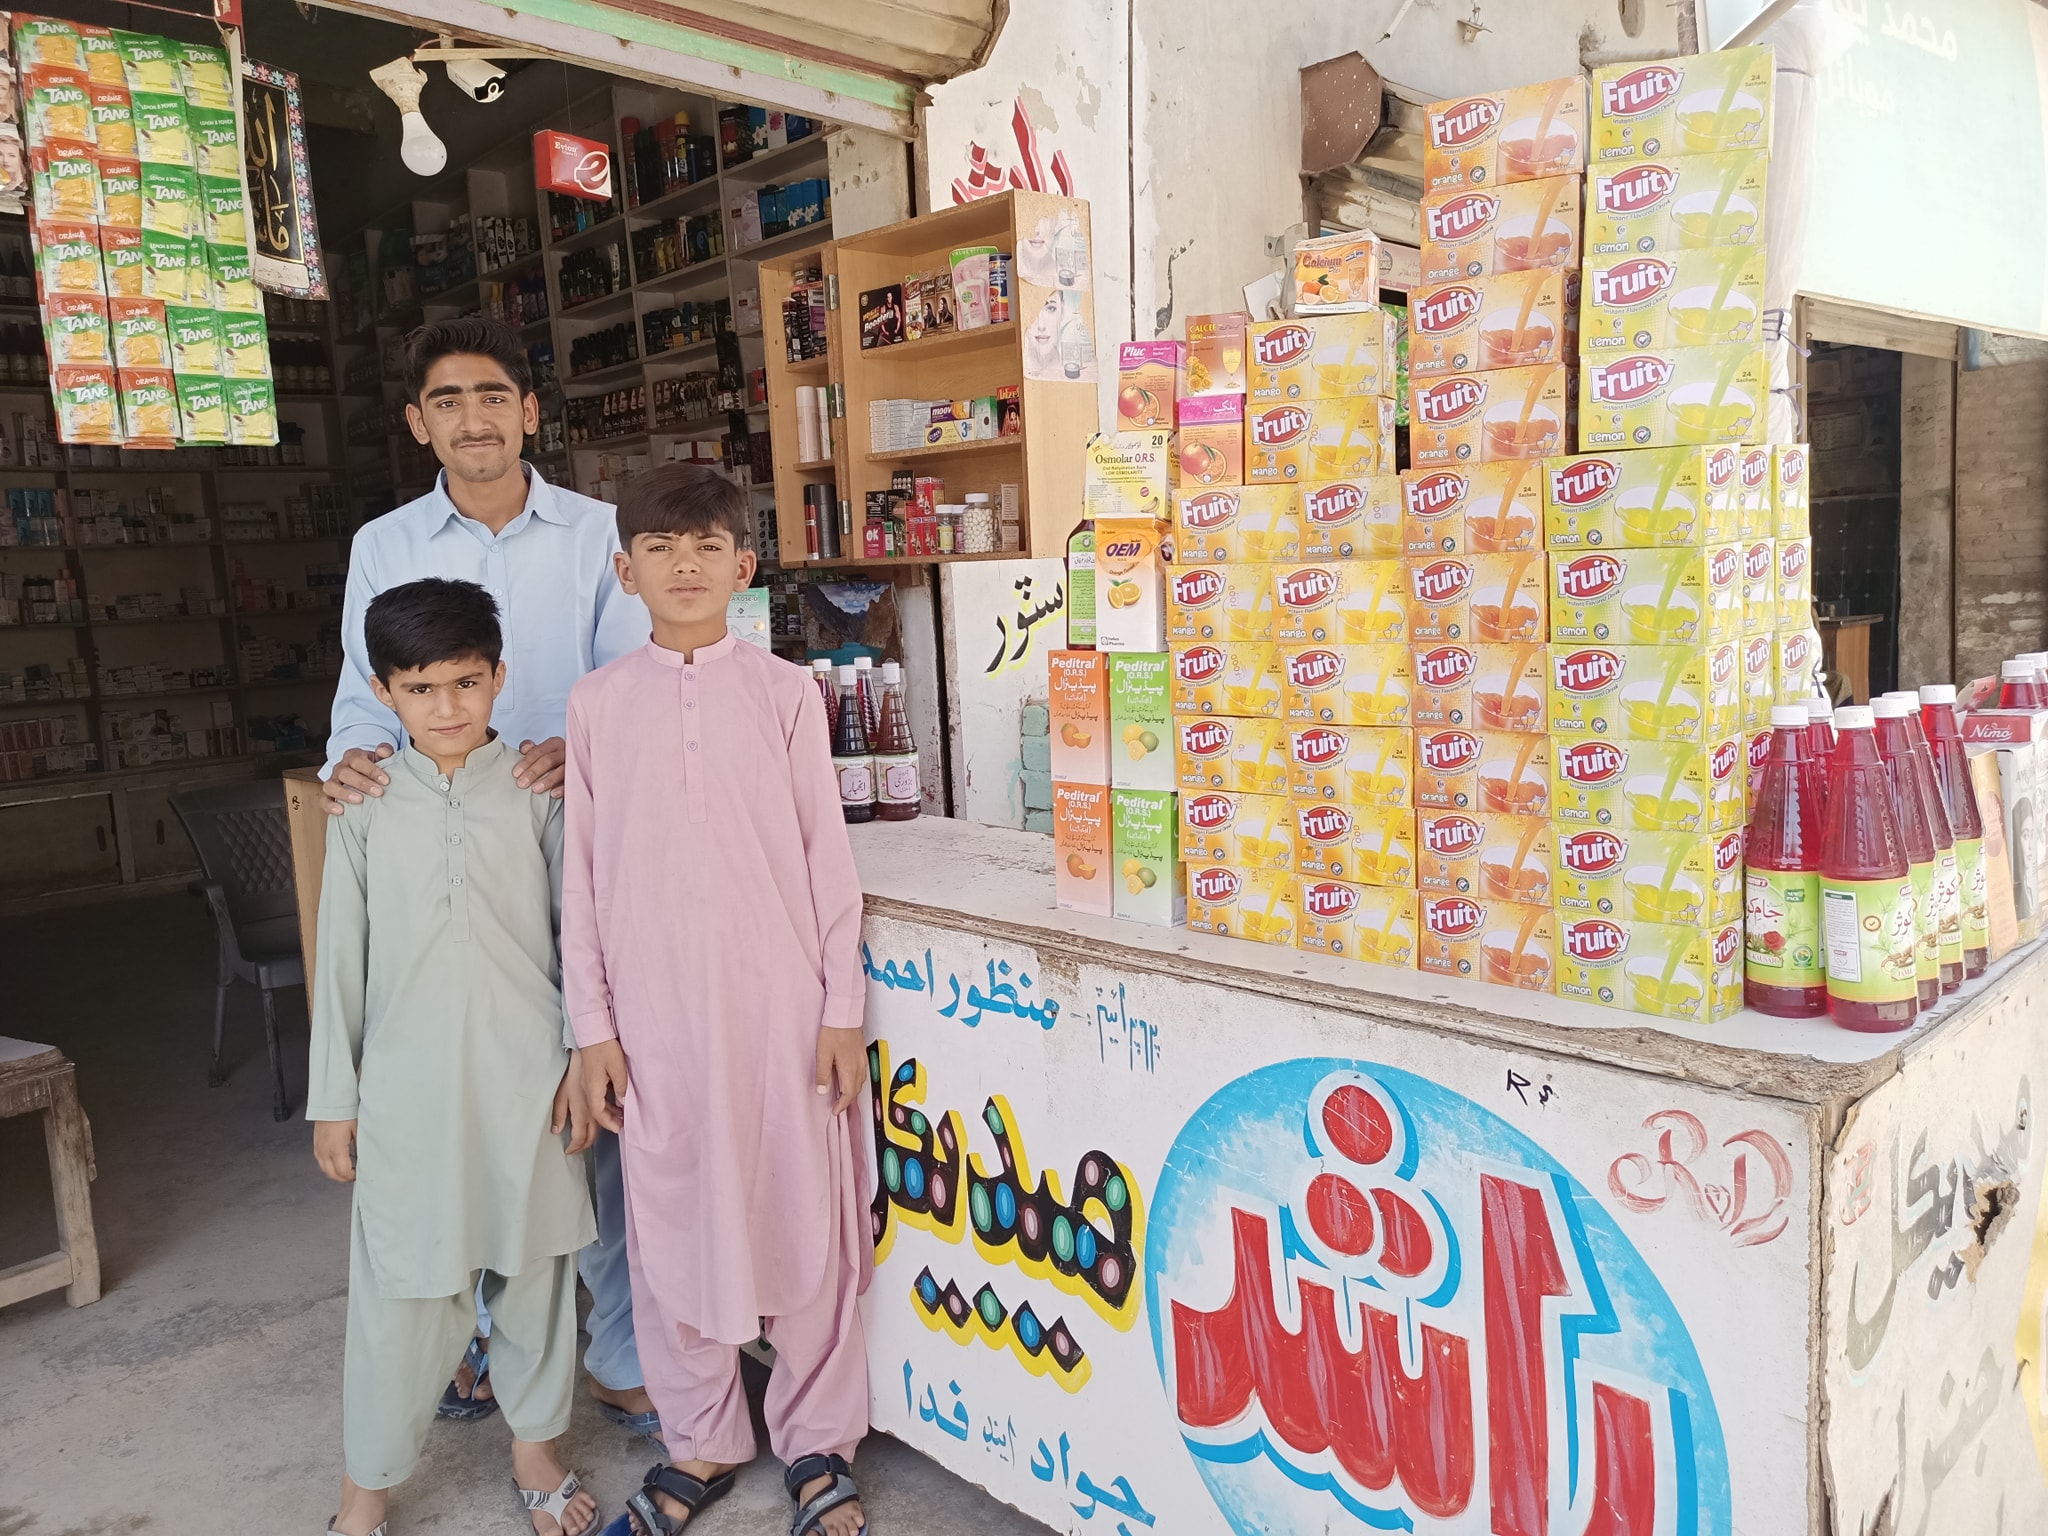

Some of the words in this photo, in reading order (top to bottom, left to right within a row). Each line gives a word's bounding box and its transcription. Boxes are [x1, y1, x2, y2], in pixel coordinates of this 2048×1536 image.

[32, 22, 70, 34] TANG
[128, 48, 164, 61] TANG
[184, 50, 217, 62] TANG
[44, 88, 82, 103] TANG
[98, 94, 123, 102] ORANGE
[1602, 68, 1684, 117] Fruity
[93, 107, 130, 122] TANG
[144, 114, 180, 129] TANG
[1431, 99, 1504, 146] Fruity
[202, 130, 236, 144] TANG
[58, 149, 84, 157] ORANGE
[1600, 145, 1634, 159] Lemon
[53, 161, 91, 177] TANG
[103, 179, 139, 193] TANG
[1432, 173, 1463, 186] Orange
[151, 185, 187, 200] TANG
[1596, 168, 1678, 214] Fruity
[1428, 196, 1499, 239] Fruity
[52, 244, 92, 259] TANG
[1594, 241, 1629, 253] Lemon
[151, 253, 185, 268] TANG
[1428, 268, 1459, 279] Orange
[1592, 262, 1677, 306] Fruity
[1413, 290, 1484, 333] Fruity
[121, 320, 156, 335] TANG
[179, 328, 212, 343] TANG
[228, 333, 261, 348] TANG
[1590, 335, 1625, 347] Lemon
[1254, 326, 1315, 364] Fruity
[135, 377, 159, 385] ORANGE
[1590, 359, 1674, 403] Fruity
[70, 387, 108, 402] TANG
[131, 390, 166, 404] TANG
[1255, 388, 1281, 397] Mango
[188, 396, 222, 410] TANG
[1417, 381, 1488, 423] Fruity
[1251, 407, 1312, 444] Fruity
[1152, 435, 1163, 445] 20
[1589, 431, 1625, 442] Lemon
[1096, 454, 1133, 464] Osmolar
[1419, 448, 1448, 460] Orange
[1252, 467, 1278, 476] Mango
[1705, 449, 1737, 486] Fruity
[1550, 462, 1622, 506] Fruity
[1406, 476, 1469, 516] Fruity
[1180, 494, 1240, 527] Fruity
[1408, 540, 1435, 551] Orange
[1551, 532, 1580, 544] Lemon
[1106, 543, 1141, 557] OEM
[1183, 549, 1209, 559] Mango
[1743, 546, 1772, 578] Fruity
[1414, 566, 1473, 607] Fruity
[1557, 558, 1628, 600] Fruity
[1172, 573, 1226, 606] Fruity
[1277, 571, 1339, 606] Fruity
[1172, 626, 1196, 636] Mango
[1279, 629, 1306, 639] Mango
[1415, 626, 1441, 636] Orange
[1557, 625, 1588, 637] Lemon
[1052, 658, 1095, 669] Peditral
[1115, 661, 1164, 671] Peditral
[1285, 652, 1346, 688] Fruity
[1416, 653, 1477, 692] Fruity
[1554, 654, 1626, 694] Fruity
[1291, 732, 1349, 766] Fruity
[1420, 734, 1482, 773] Fruity
[1558, 746, 1628, 782] Fruity
[1057, 789, 1099, 803] Peditral
[1293, 785, 1318, 795] Mango
[1117, 796, 1163, 810] Peditral
[1421, 793, 1448, 803] Orange
[1559, 808, 1589, 820] Lemon
[1298, 810, 1353, 841] Fruity
[1423, 820, 1485, 856] Fruity
[1559, 835, 1628, 874] Fruity
[1191, 872, 1242, 902] Fruity
[1303, 885, 1359, 916] Fruity
[1192, 920, 1212, 930] Mango
[1426, 901, 1487, 939] Fruity
[1562, 924, 1631, 963] Fruity
[1712, 929, 1739, 964] Fruity
[1425, 957, 1451, 967] Orange
[1562, 985, 1592, 997] Lemon
